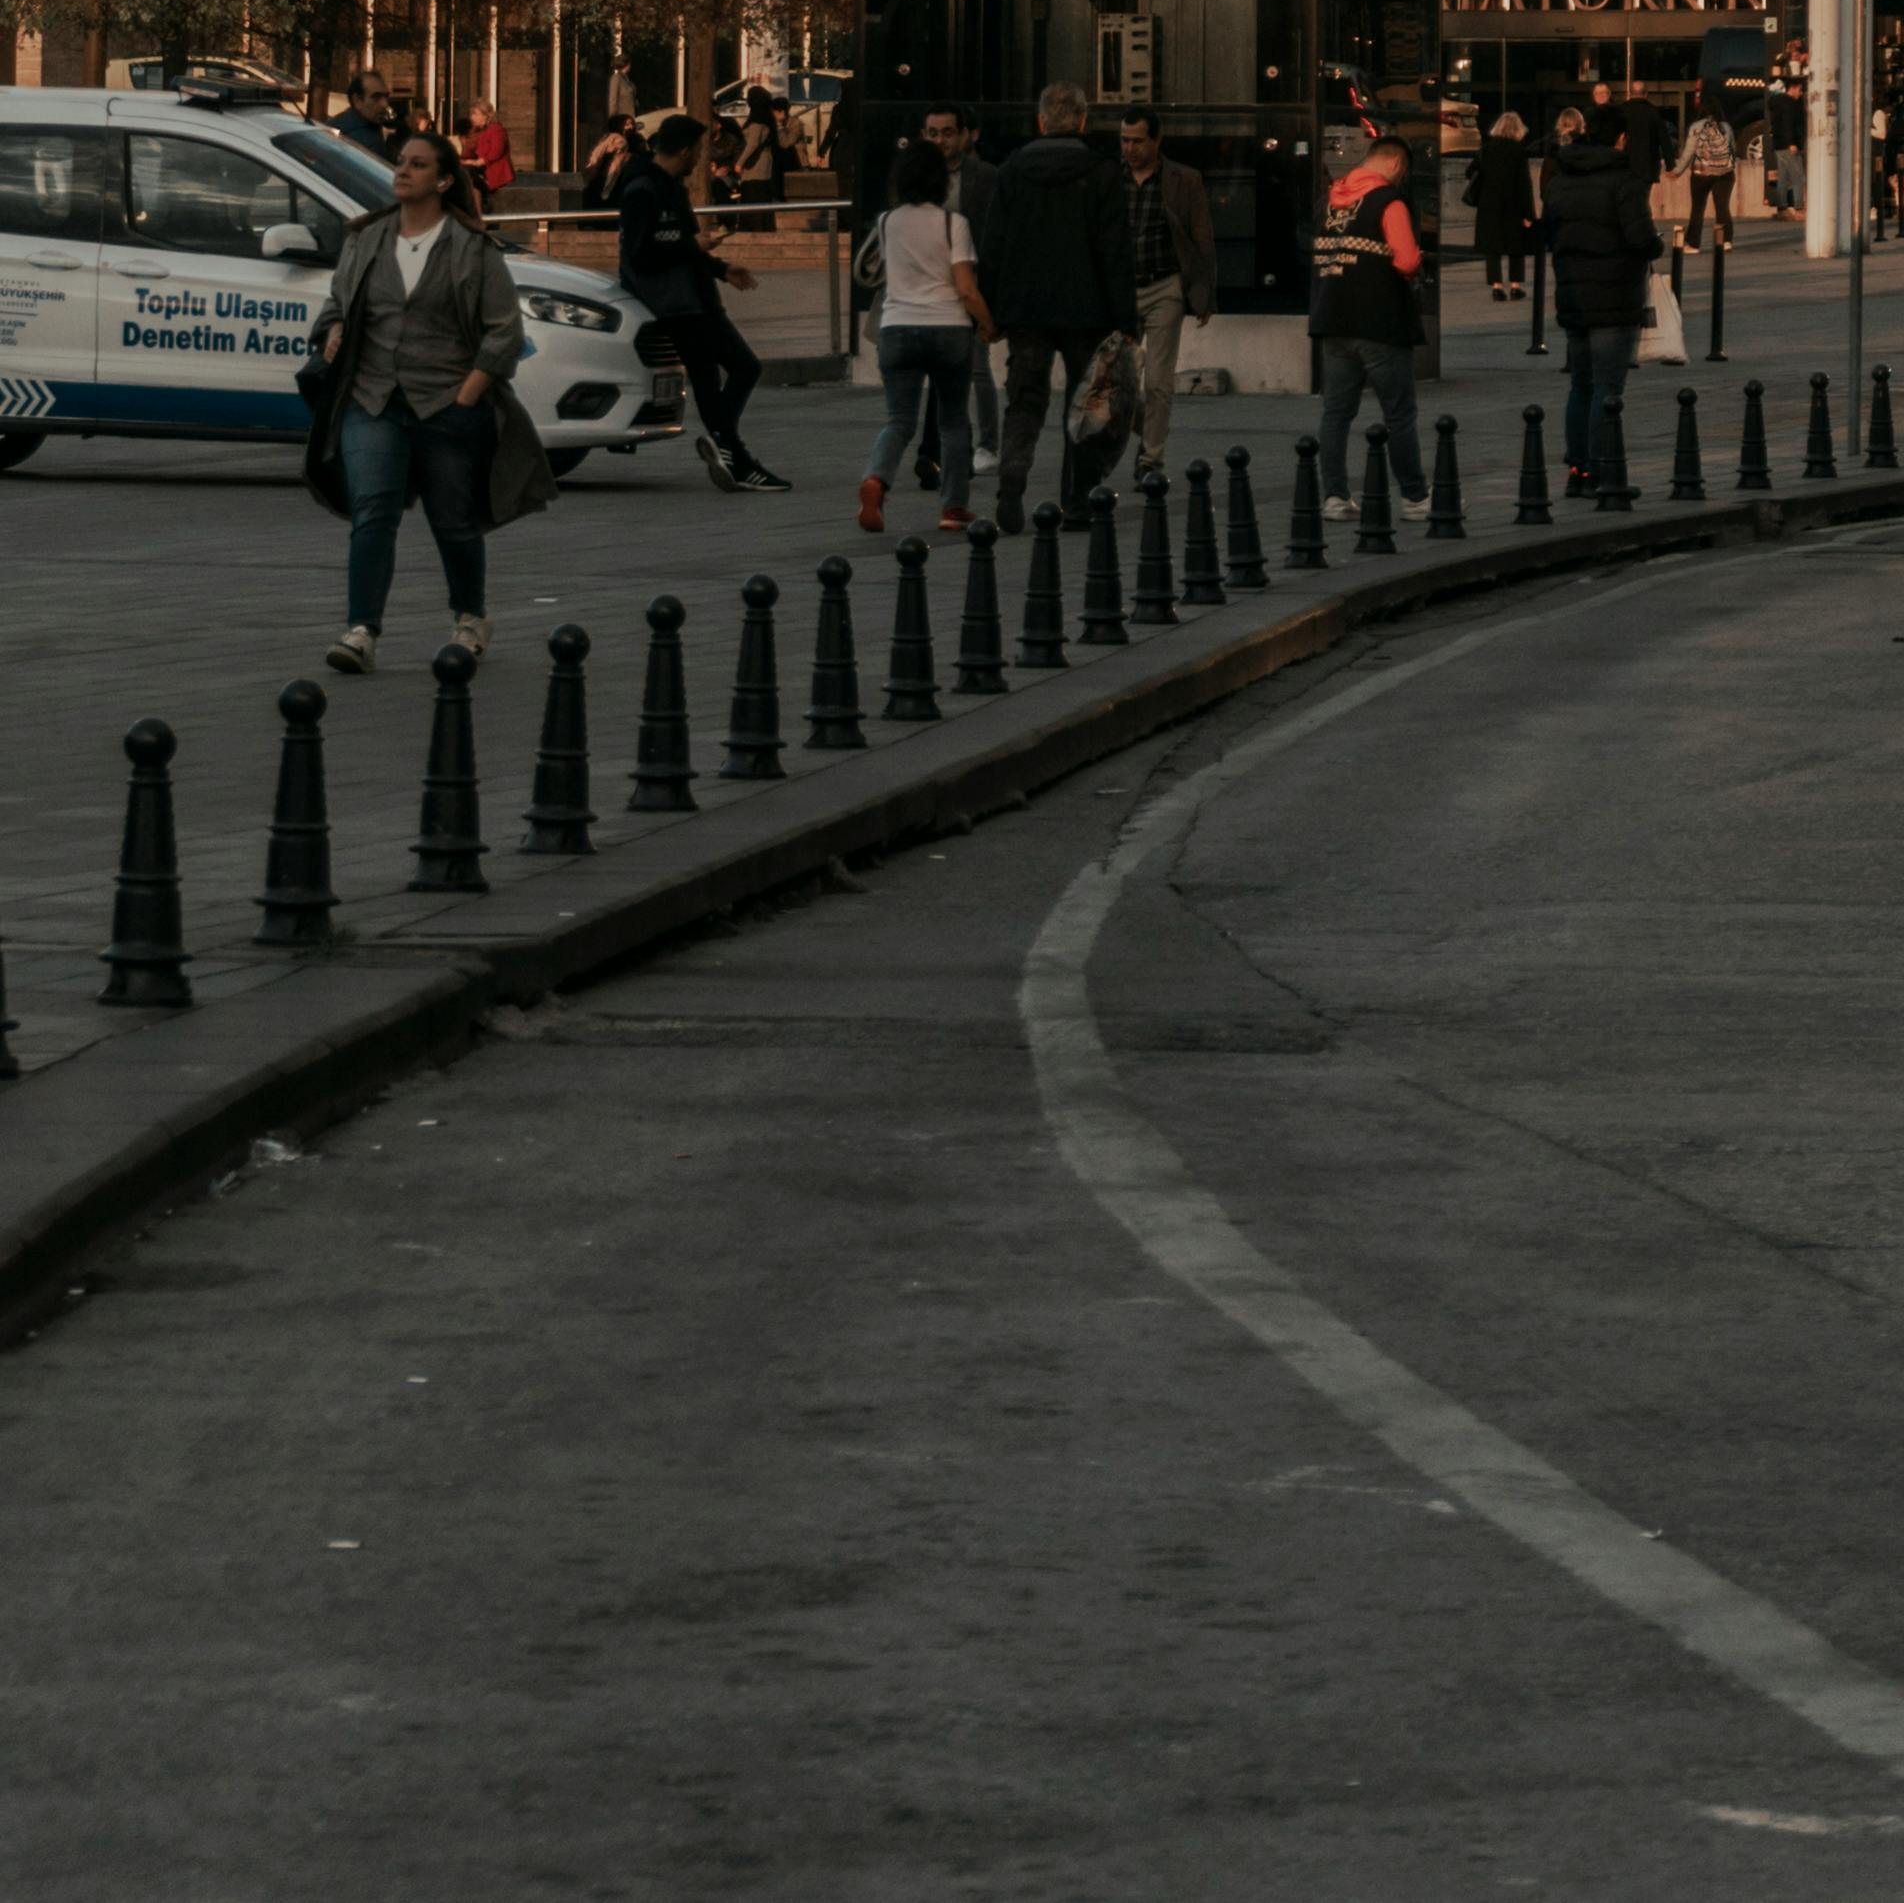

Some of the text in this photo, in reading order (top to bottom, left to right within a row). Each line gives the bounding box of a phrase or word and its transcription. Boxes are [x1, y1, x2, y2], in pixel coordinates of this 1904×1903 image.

[0, 287, 66, 302] ÜYÜKŞEHİR
[135, 288, 308, 327] Toplu Ulaşım
[122, 321, 318, 357] Denetim Aracı
